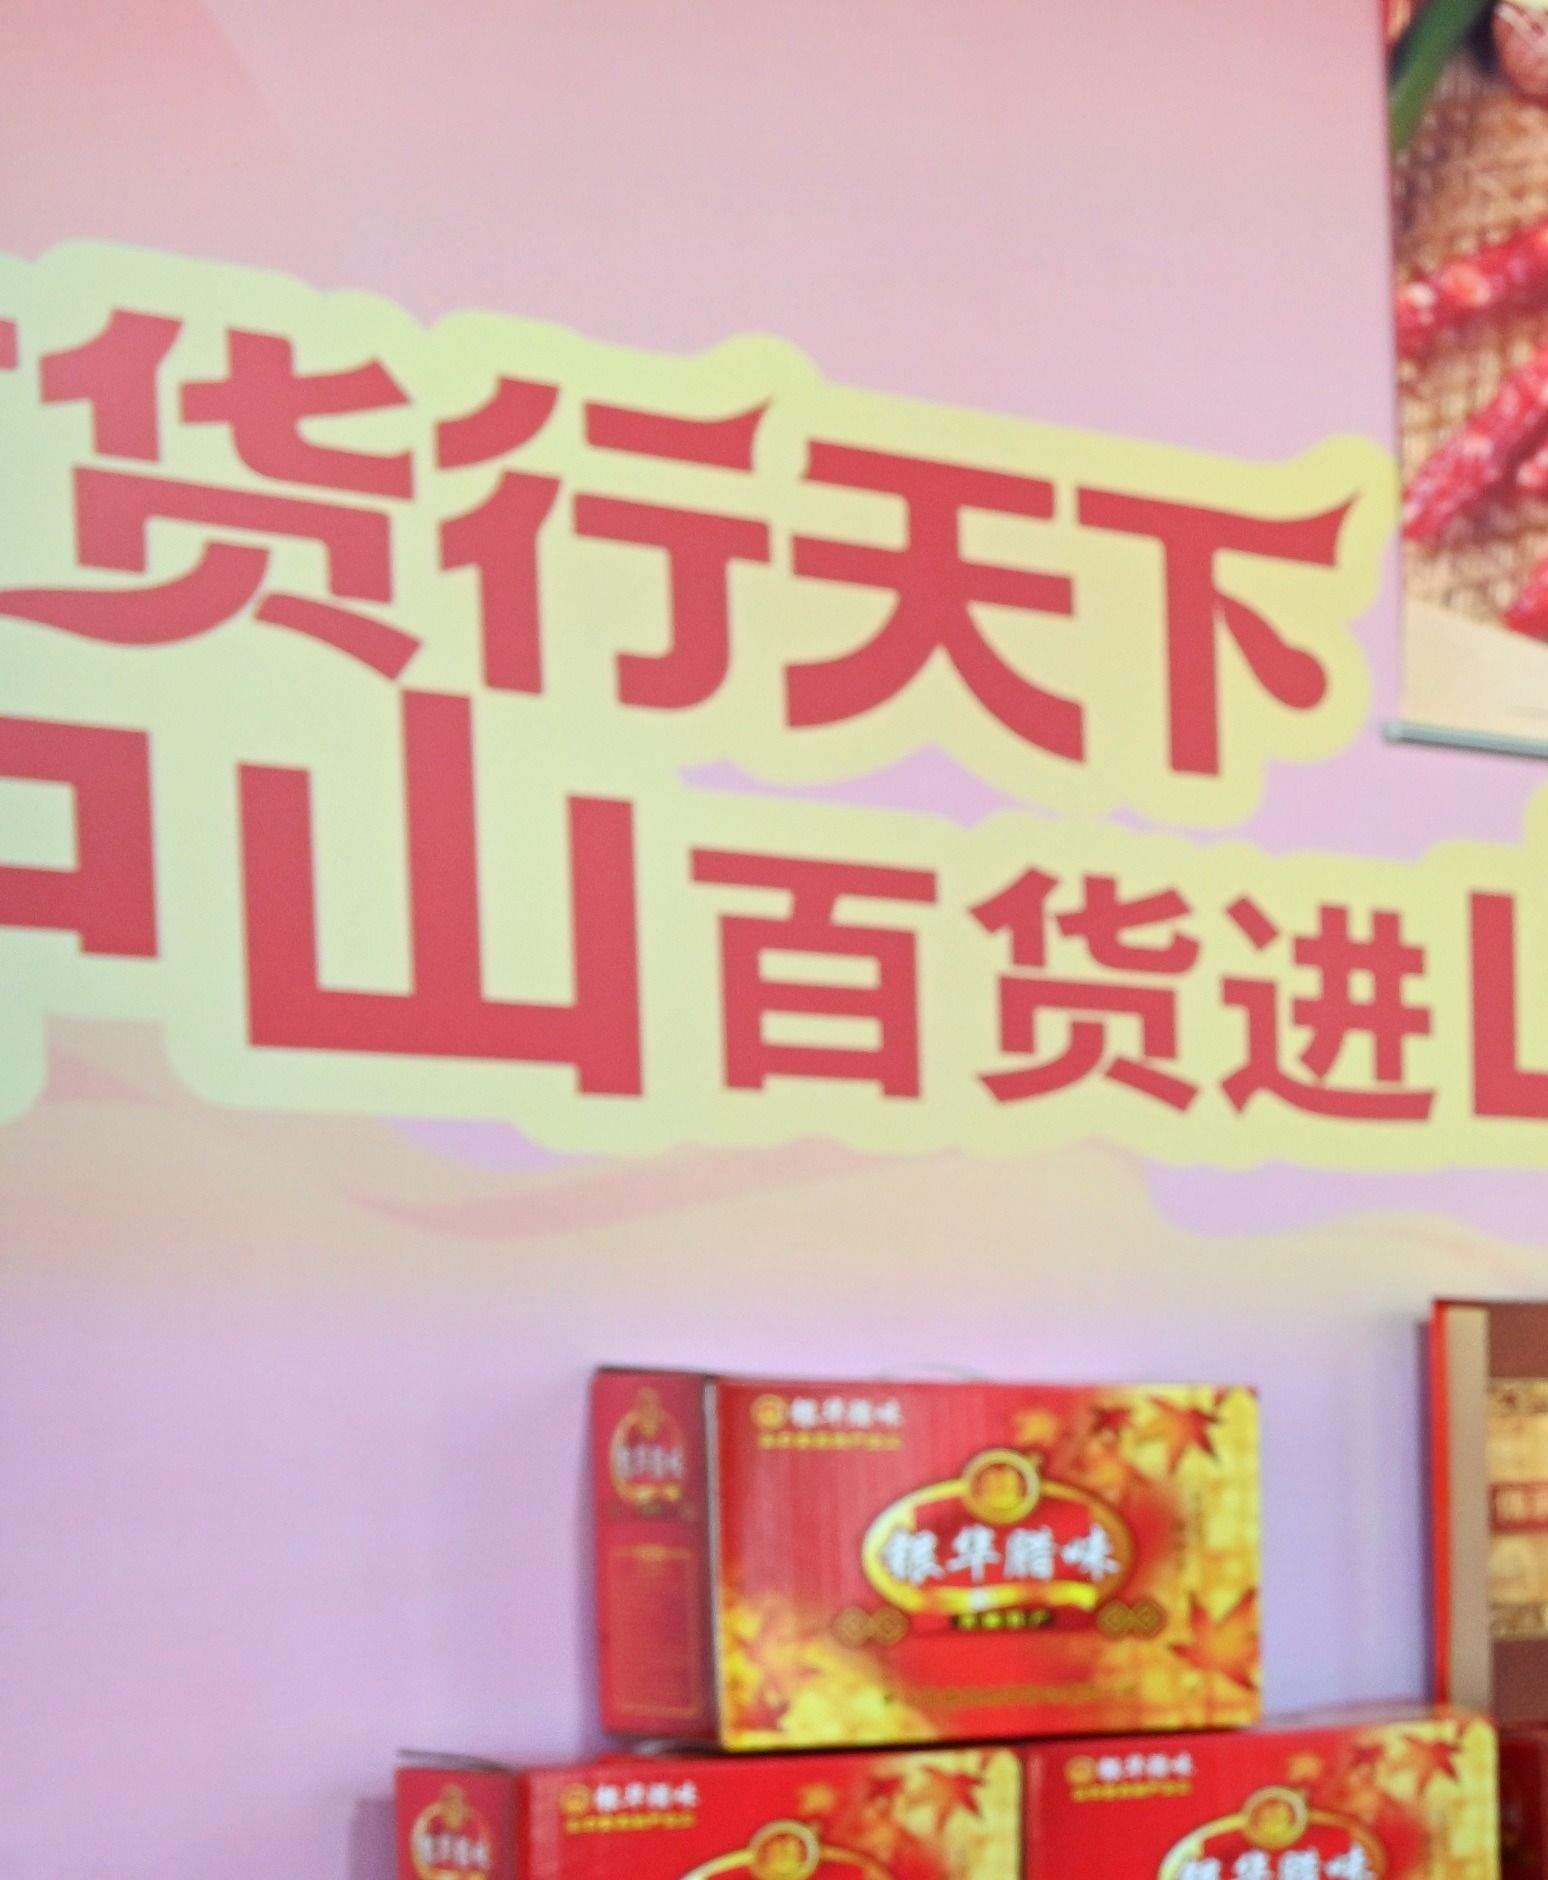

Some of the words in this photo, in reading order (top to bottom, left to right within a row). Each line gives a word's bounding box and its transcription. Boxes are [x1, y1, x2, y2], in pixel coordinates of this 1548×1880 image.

[0, 308, 1360, 776] 货行天下
[880, 1525, 1121, 1584] 银华腊味
